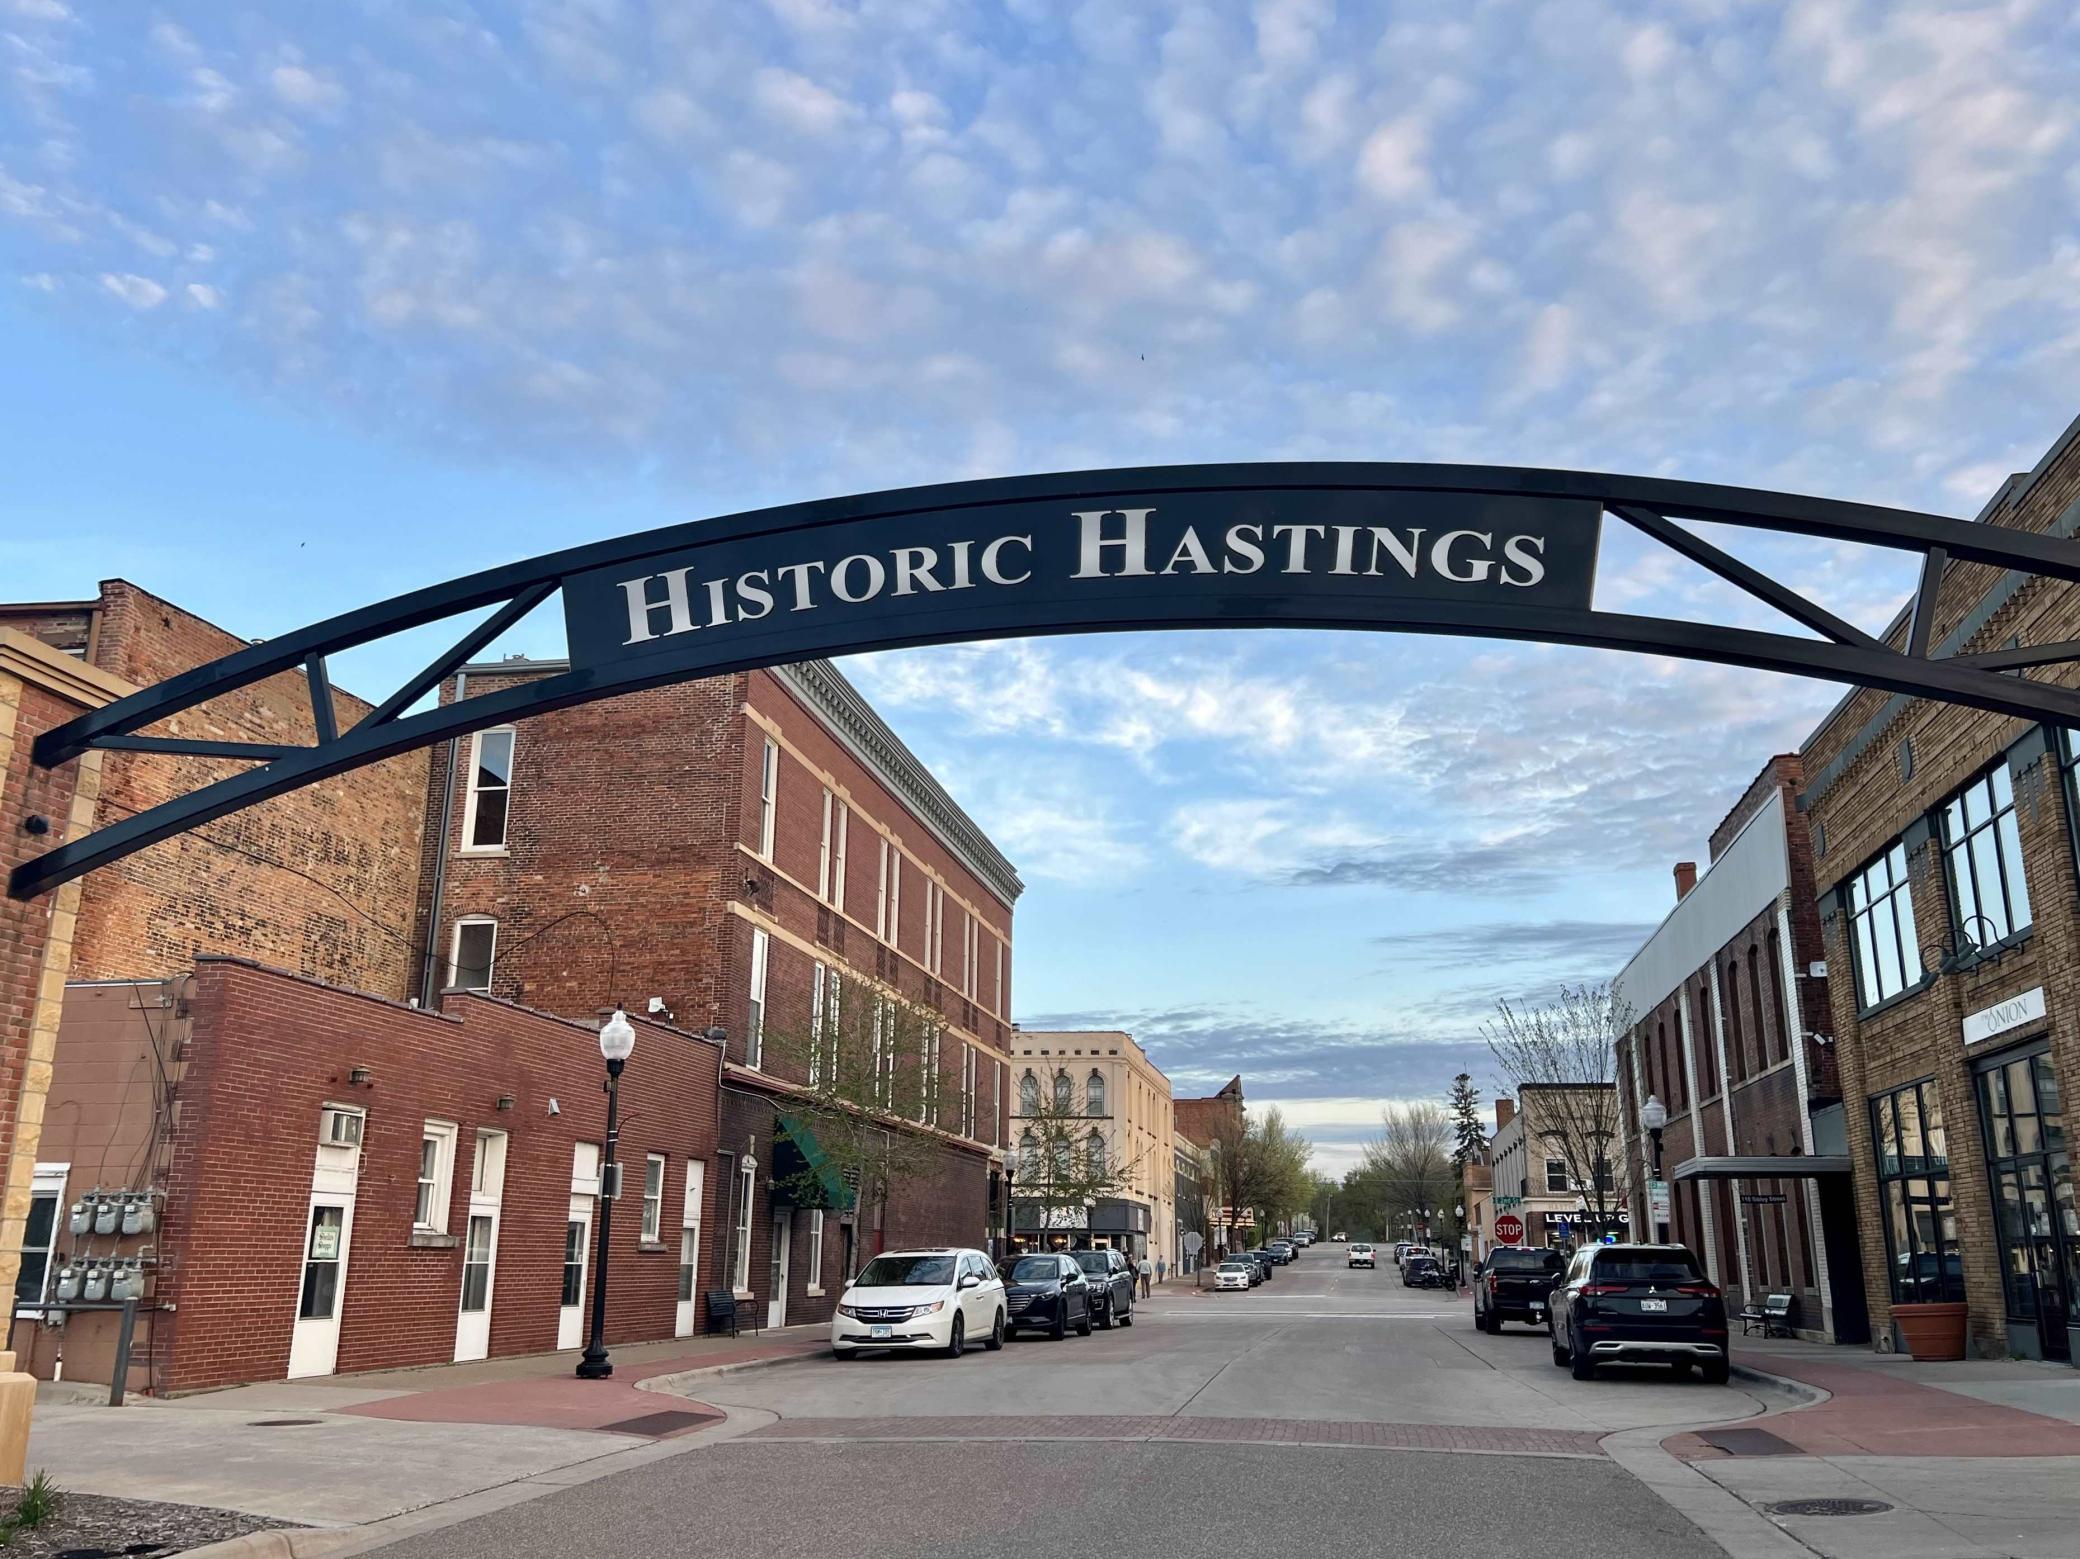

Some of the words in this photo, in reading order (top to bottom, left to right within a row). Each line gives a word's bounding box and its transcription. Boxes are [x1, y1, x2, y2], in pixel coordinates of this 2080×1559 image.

[616, 534, 1033, 646] HISTORIC
[1069, 507, 1546, 588] HASTINGS
[1987, 998, 2028, 1033] ONION
[1496, 1224, 1522, 1235] STOP
